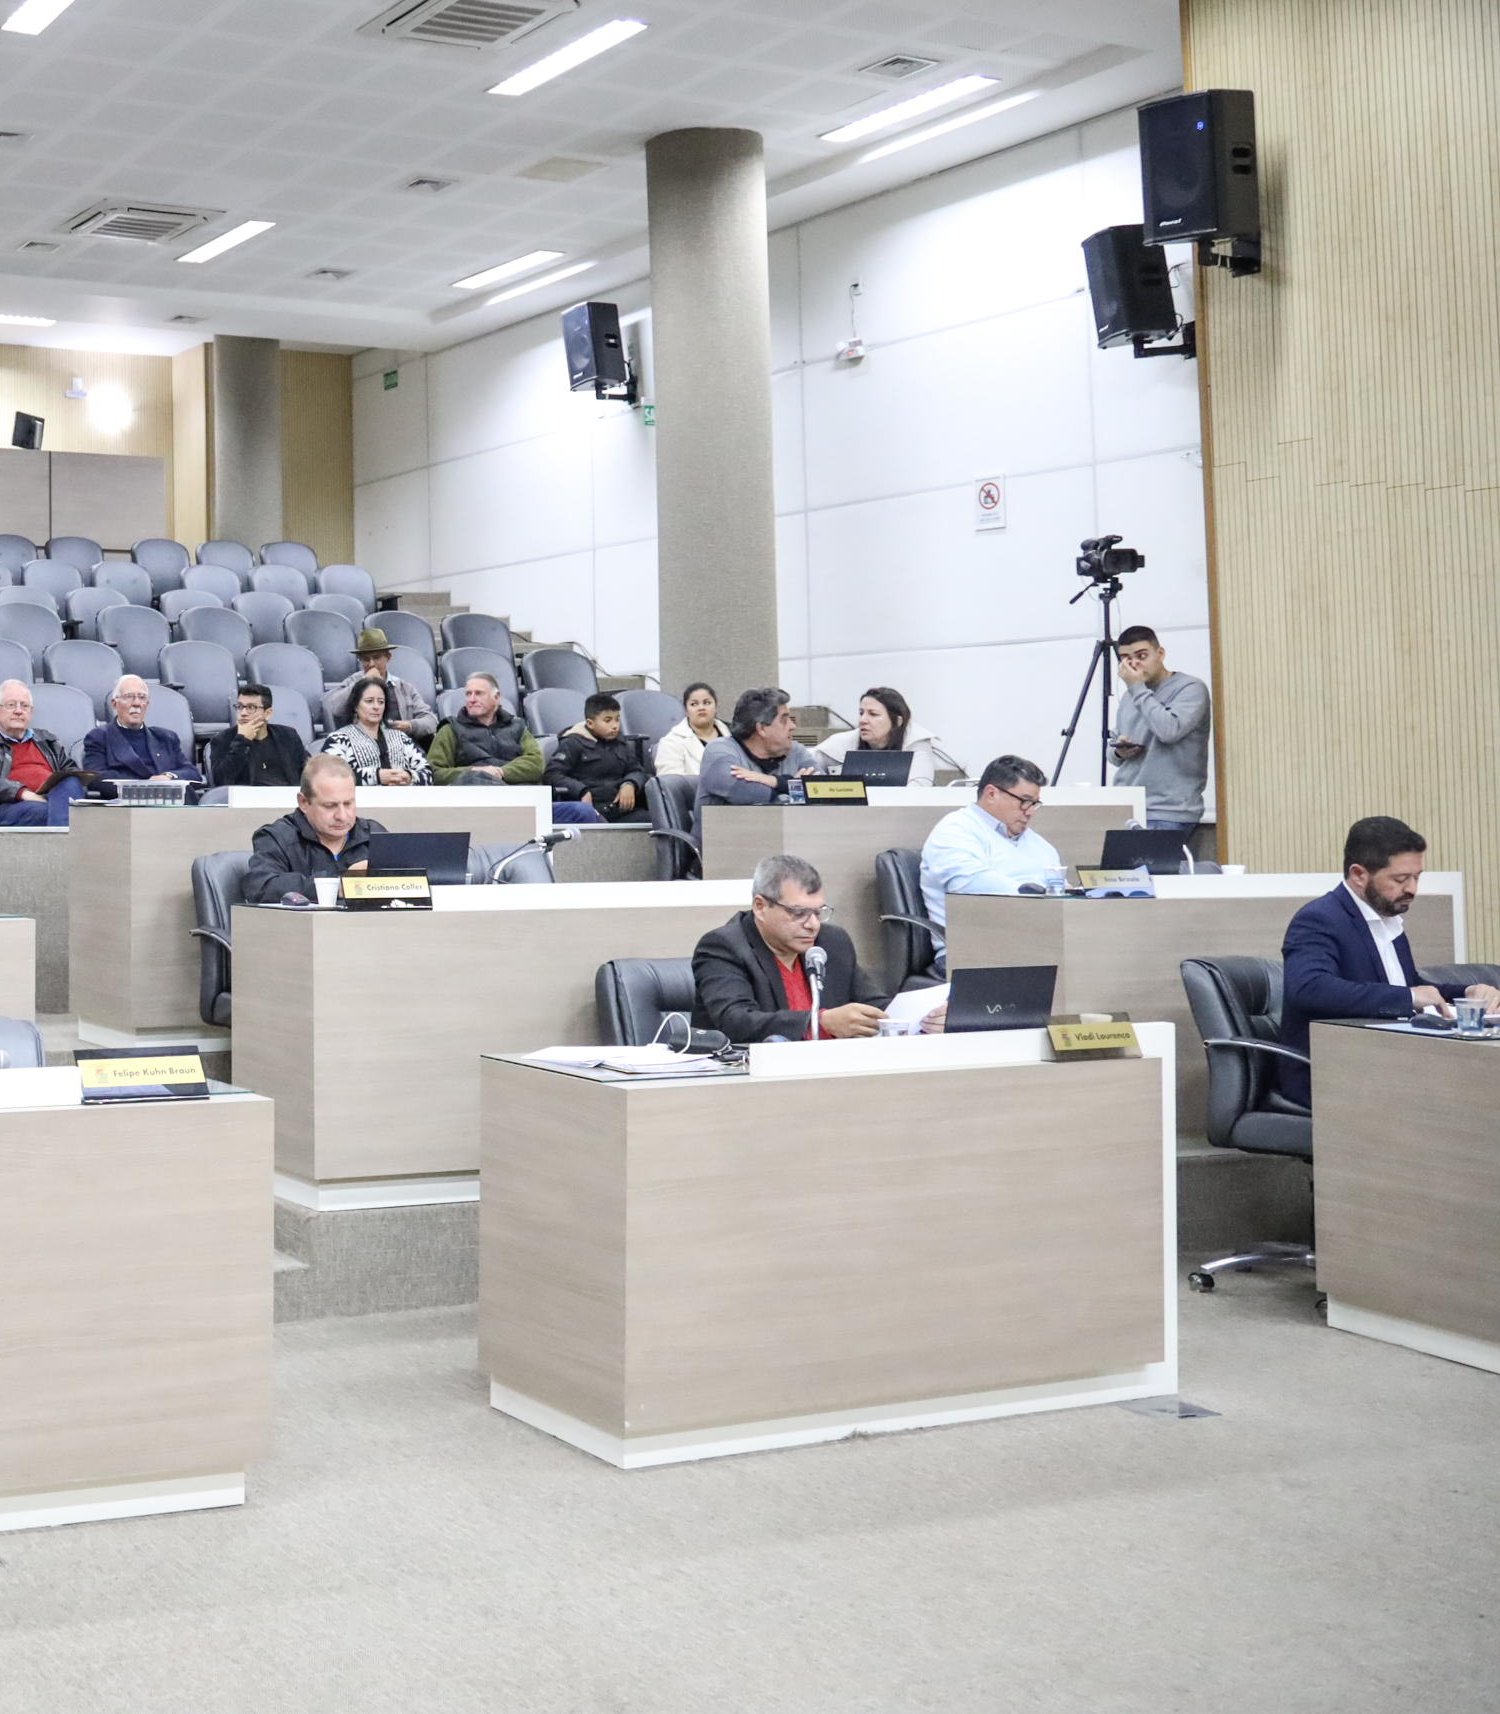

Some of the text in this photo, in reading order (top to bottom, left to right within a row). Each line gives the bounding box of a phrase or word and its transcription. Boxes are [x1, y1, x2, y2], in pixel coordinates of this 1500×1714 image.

[1074, 1032, 1131, 1041] Vladi Lourenço
[113, 1067, 196, 1078] Felipe Kuhn Braun
